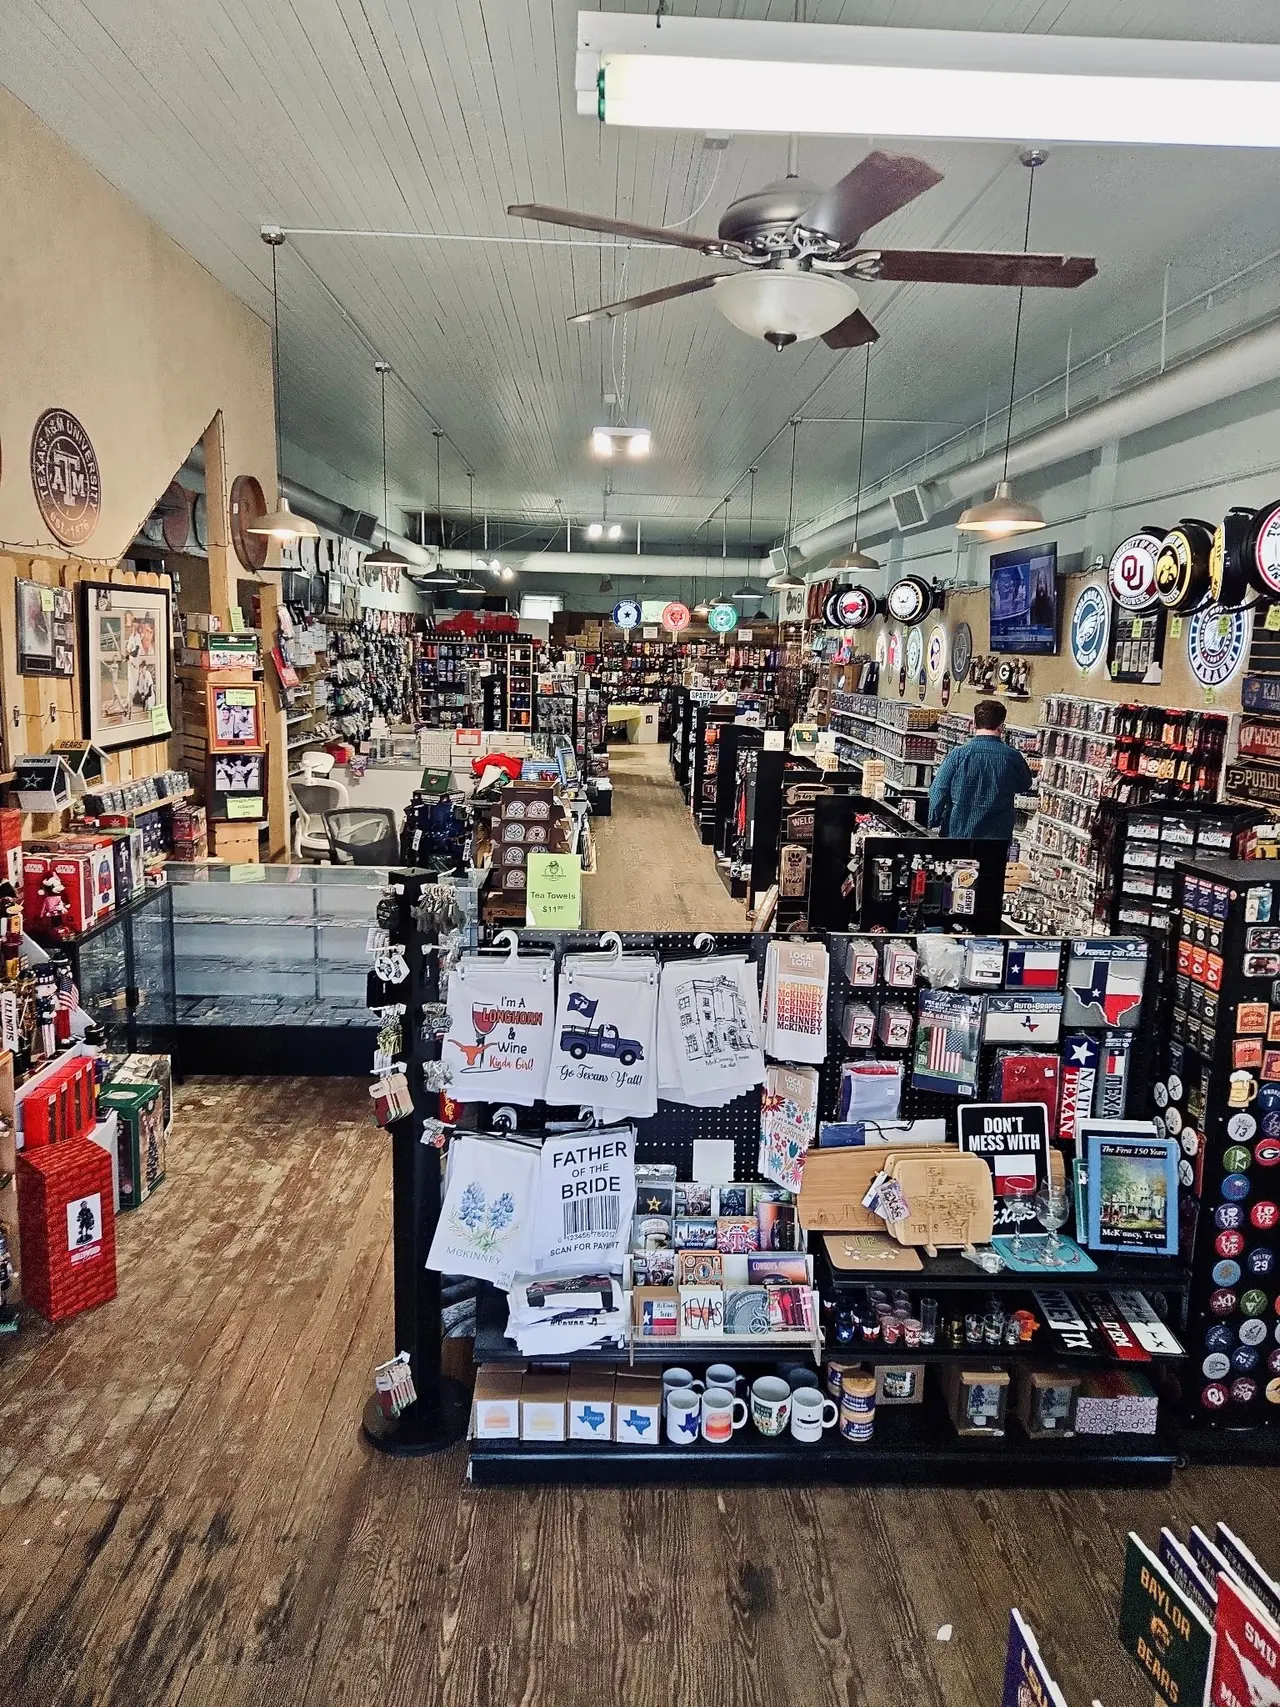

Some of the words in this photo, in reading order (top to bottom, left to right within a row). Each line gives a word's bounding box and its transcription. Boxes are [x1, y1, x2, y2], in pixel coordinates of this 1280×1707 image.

[38, 438, 49, 500] TEXAS
[66, 420, 98, 512] UNIVERSITY
[1120, 592, 1149, 605] SOONERS
[60, 741, 83, 749] BEARS
[547, 892, 576, 900] Towels
[789, 951, 815, 961] LOCAL
[1085, 949, 1111, 957] PERFECT
[792, 959, 813, 968] LOVE
[778, 981, 823, 994] McKINNEY
[778, 989, 823, 1002] McKINNEY
[501, 997, 516, 1008] I'm
[518, 998, 526, 1008] A
[778, 998, 823, 1010] McKINNEY
[482, 1008, 543, 1026] LONGHORN
[777, 1006, 823, 1018] McKINNEY
[6, 999, 14, 1041] ILLINOIS
[777, 1014, 822, 1026] McKINNEY
[507, 1027, 516, 1040] &
[777, 1022, 822, 1035] McKINNEY
[497, 1042, 527, 1055] Wine
[489, 1055, 512, 1069] Kinda
[515, 1056, 534, 1071] Girl!
[556, 1065, 574, 1083] Go
[577, 1064, 608, 1083] Texans
[611, 1071, 644, 1088] Y'all!
[785, 1075, 804, 1088] LOCAL
[786, 1082, 802, 1094] LOVE
[1059, 1072, 1079, 1134] TEXAN
[984, 1117, 1024, 1134] DON'T
[969, 1135, 1004, 1151] MESS
[1007, 1134, 1040, 1150] WITH
[553, 1141, 627, 1168] FATHER
[1101, 1145, 1114, 1154] The
[1115, 1146, 1132, 1155] First
[1133, 1148, 1148, 1156] 150
[1149, 1149, 1167, 1157] Years
[572, 1168, 586, 1178] OF
[589, 1163, 609, 1174] THE
[562, 1177, 620, 1199] BRIDE
[911, 1224, 939, 1234] TEXS
[1144, 1231, 1166, 1240] Texas
[550, 1246, 572, 1256] SCAN
[574, 1243, 590, 1251] FOR
[1254, 1261, 1269, 1272] 29
[682, 1297, 723, 1330] TEXAS
[1061, 1332, 1092, 1349] TX
[1141, 1566, 1191, 1642] BAYLOR
[1245, 1621, 1277, 1669] SMU
[1137, 1637, 1178, 1703] BEARS
